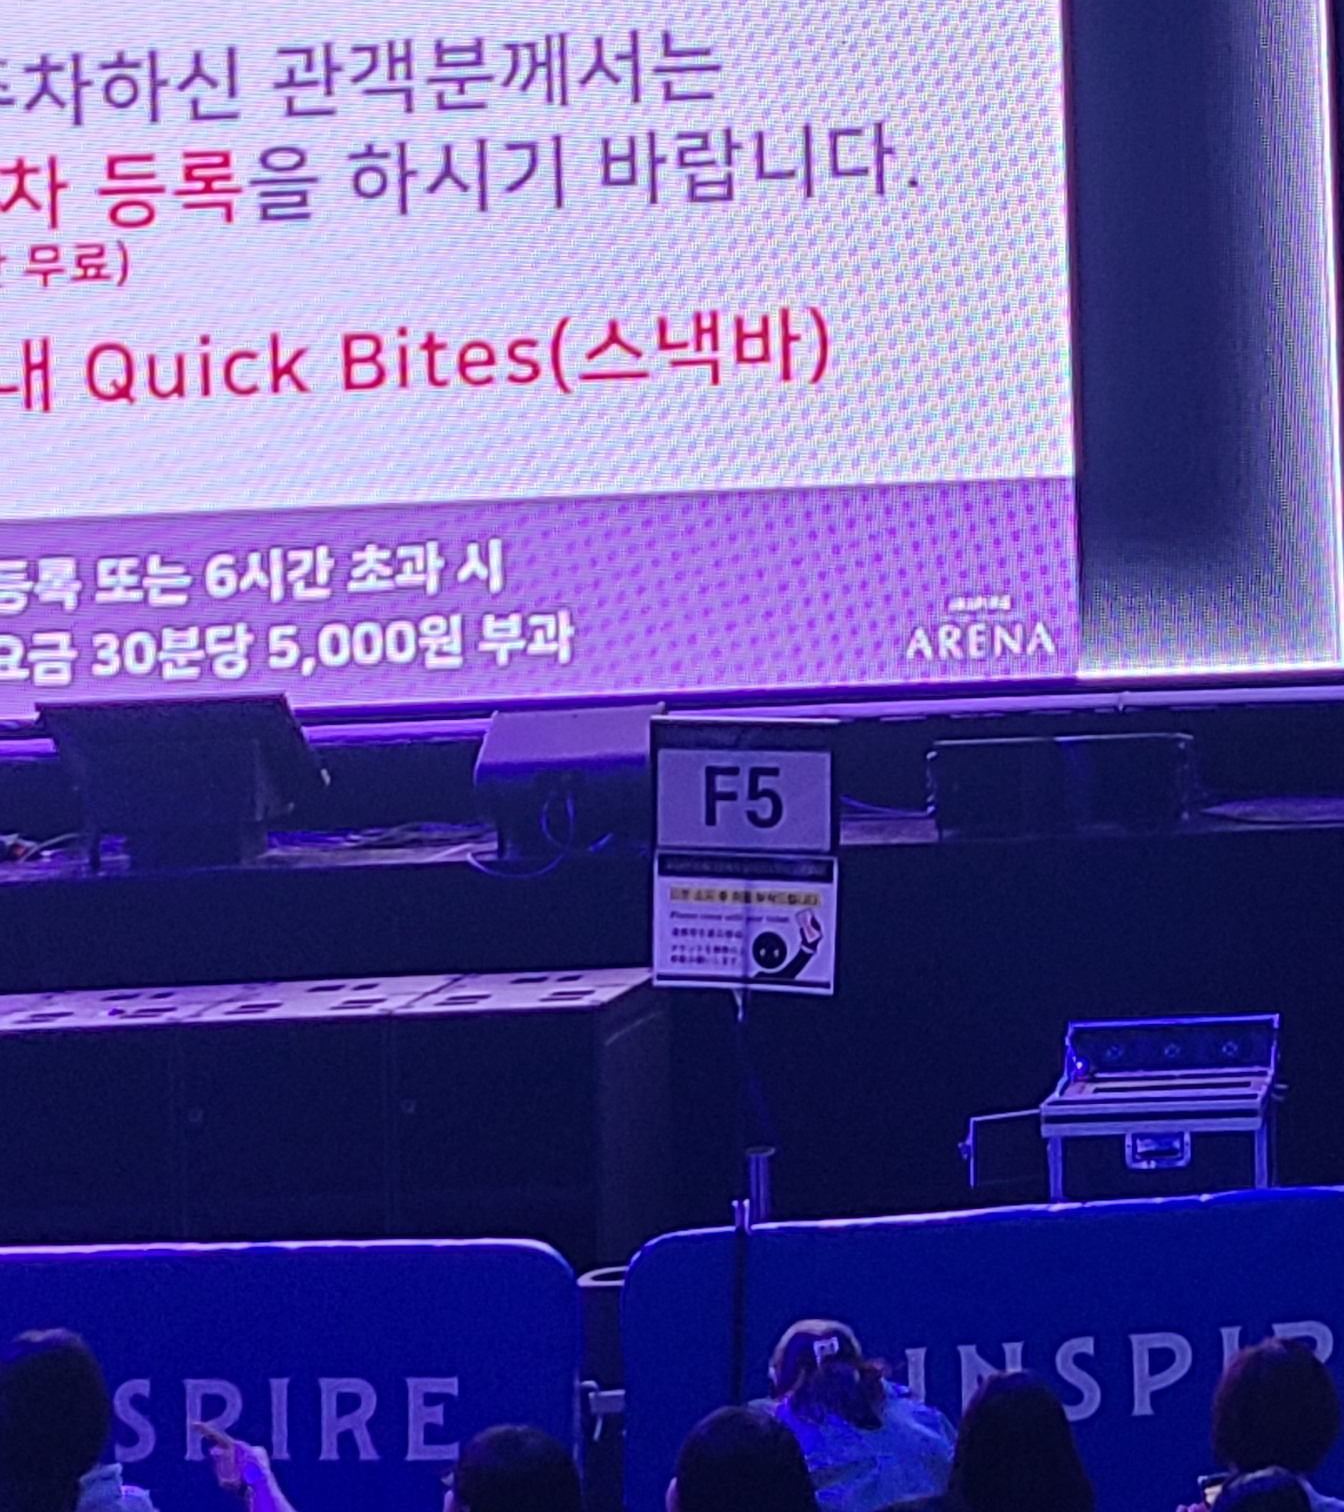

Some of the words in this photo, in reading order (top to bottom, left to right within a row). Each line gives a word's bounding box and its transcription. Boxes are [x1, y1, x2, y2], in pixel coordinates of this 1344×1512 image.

[273, 31, 723, 118] 관객분께서는
[97, 144, 321, 230] 등록을
[349, 134, 566, 215] 하시기
[599, 120, 921, 207] 바랍니다.
[23, 237, 130, 289] 무료)
[84, 331, 308, 406] Quick
[339, 306, 833, 396] Bites(스낵바)
[94, 552, 193, 608] 또는
[203, 544, 335, 604] 6시간
[346, 538, 445, 596] 초과
[456, 536, 504, 593] 시
[91, 622, 255, 683] 30분당
[267, 612, 465, 678] 5,000원
[477, 608, 575, 667] 부과
[905, 621, 1057, 662] ARENA
[703, 765, 784, 830] F5
[112, 1375, 461, 1463] SPIRE
